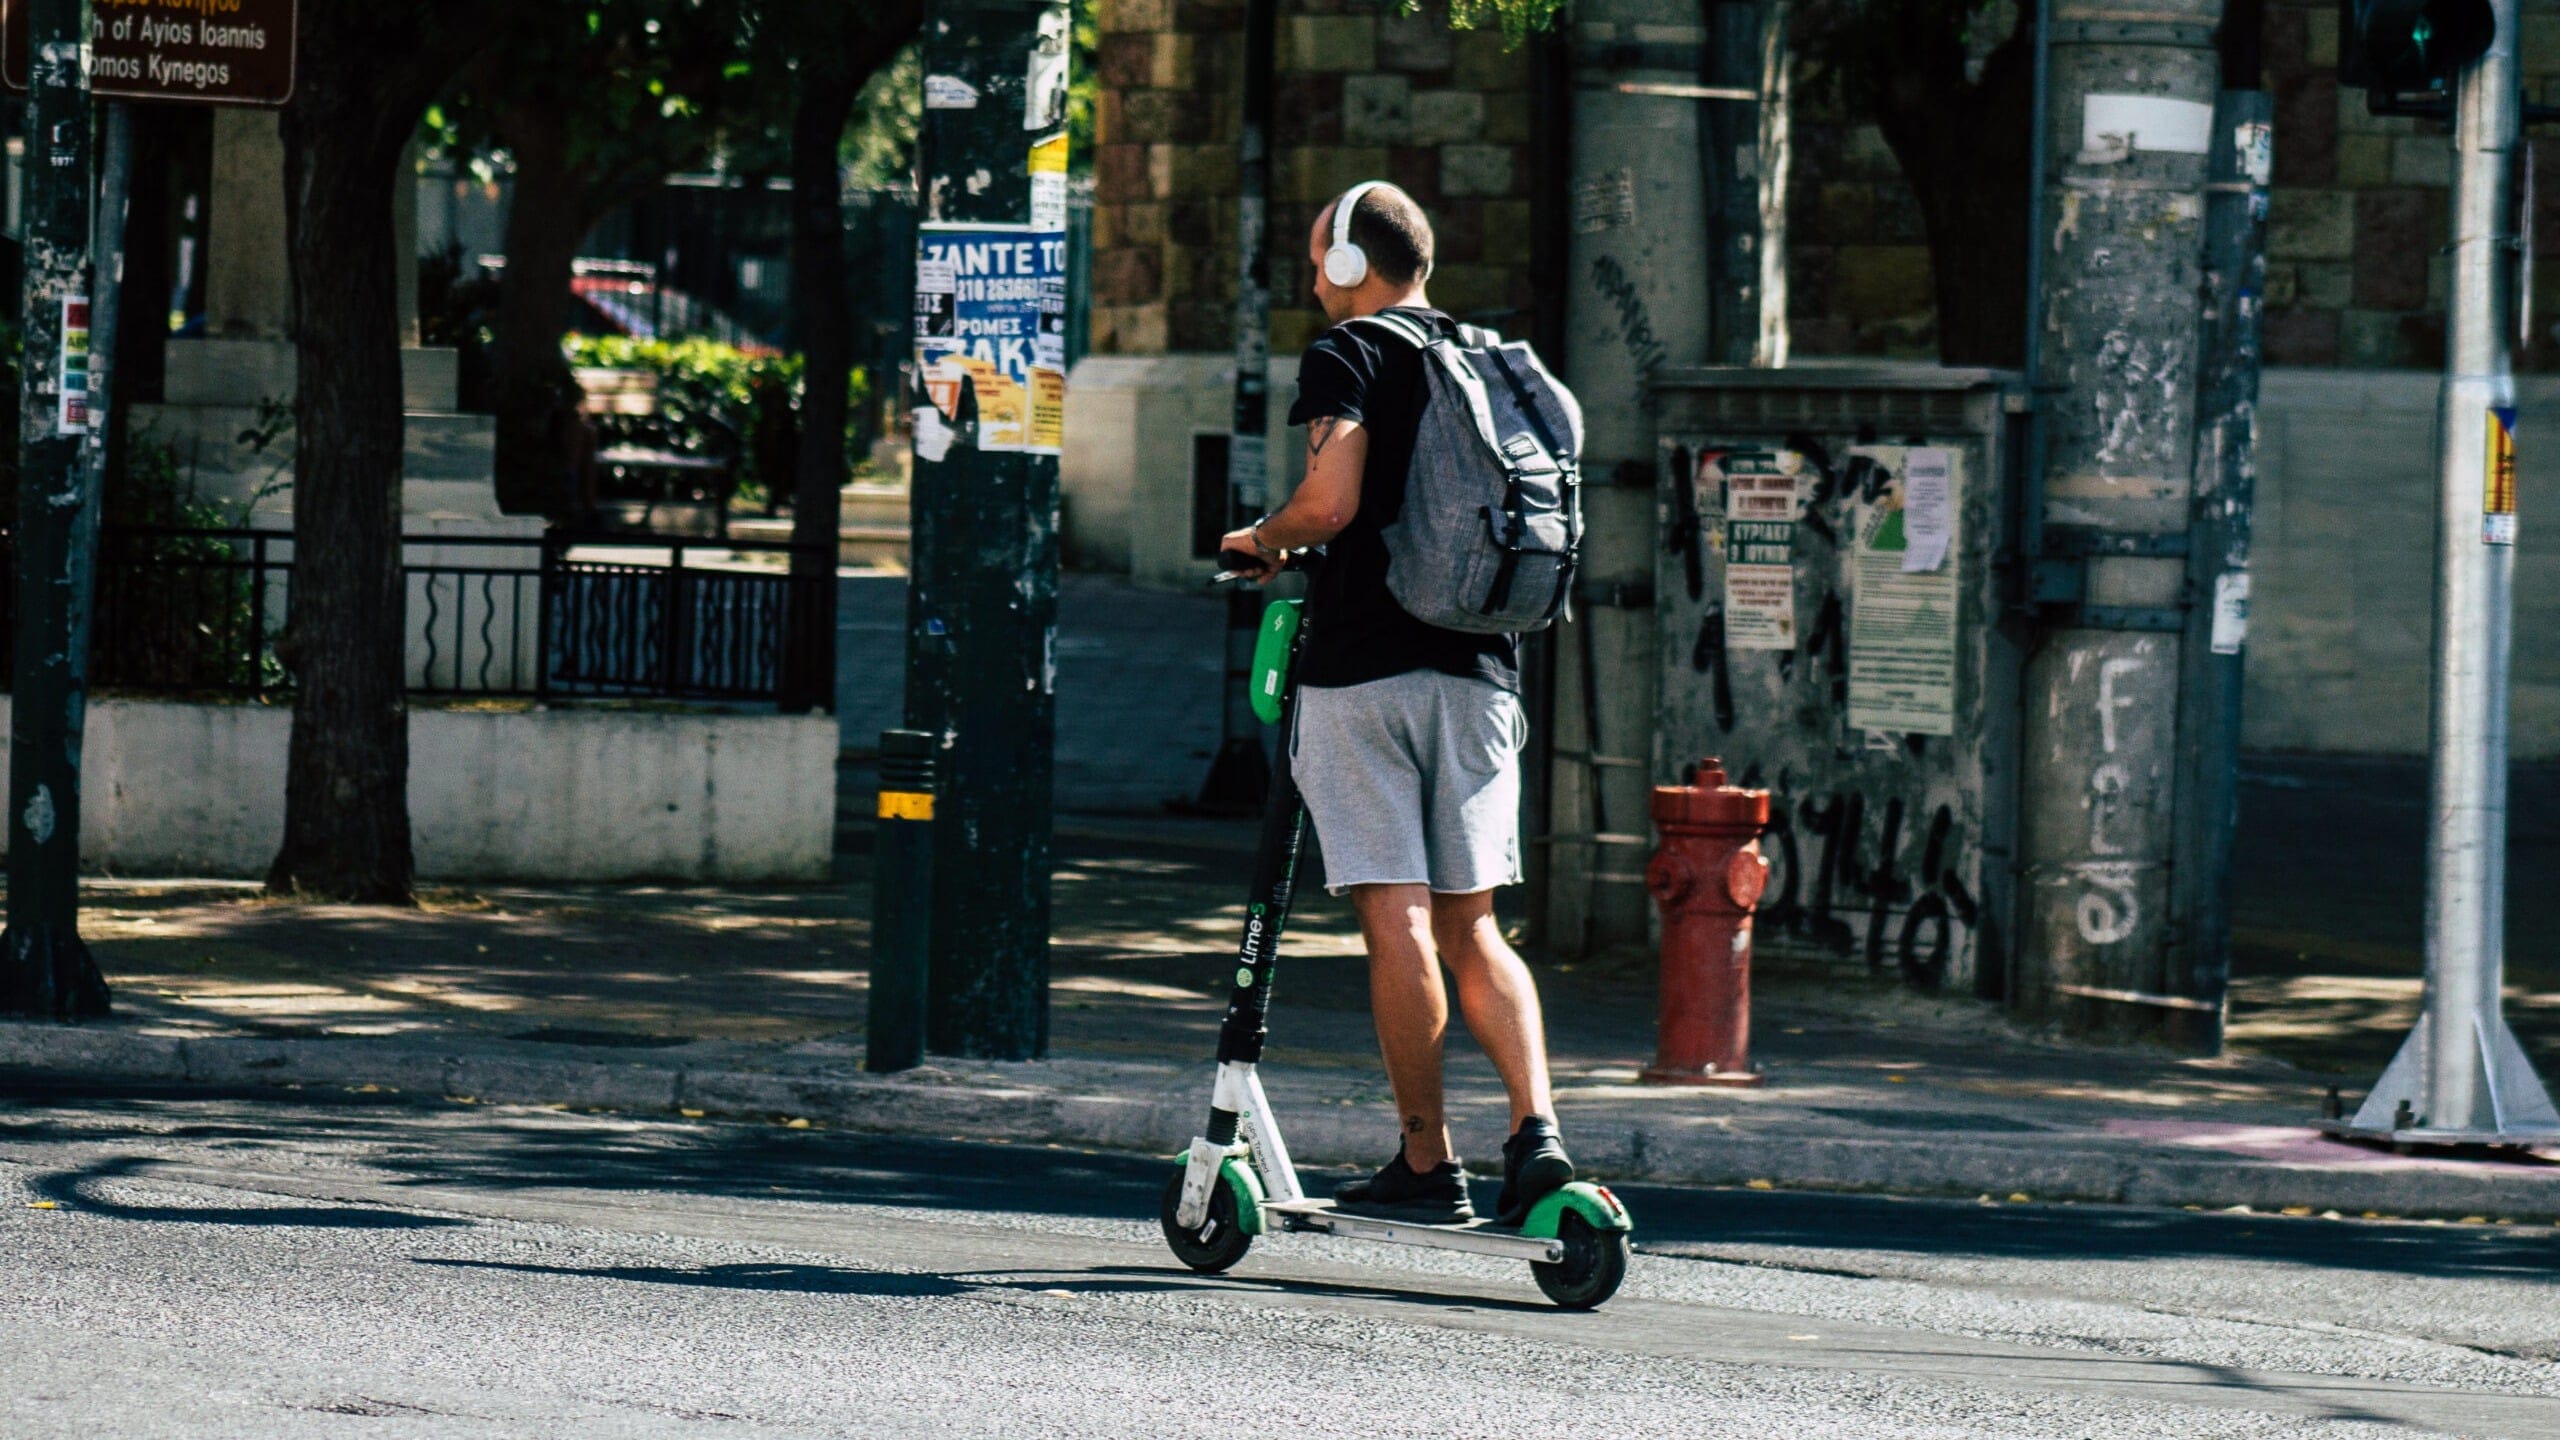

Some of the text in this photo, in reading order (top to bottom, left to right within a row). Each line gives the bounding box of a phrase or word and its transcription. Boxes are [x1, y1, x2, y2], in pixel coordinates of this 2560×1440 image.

[112, 15, 132, 41] of
[140, 16, 192, 47] Ayios
[200, 20, 266, 49] Ioannis
[148, 53, 230, 89] Kynegos
[927, 242, 1035, 276] ZANTE
[957, 279, 985, 301] 210
